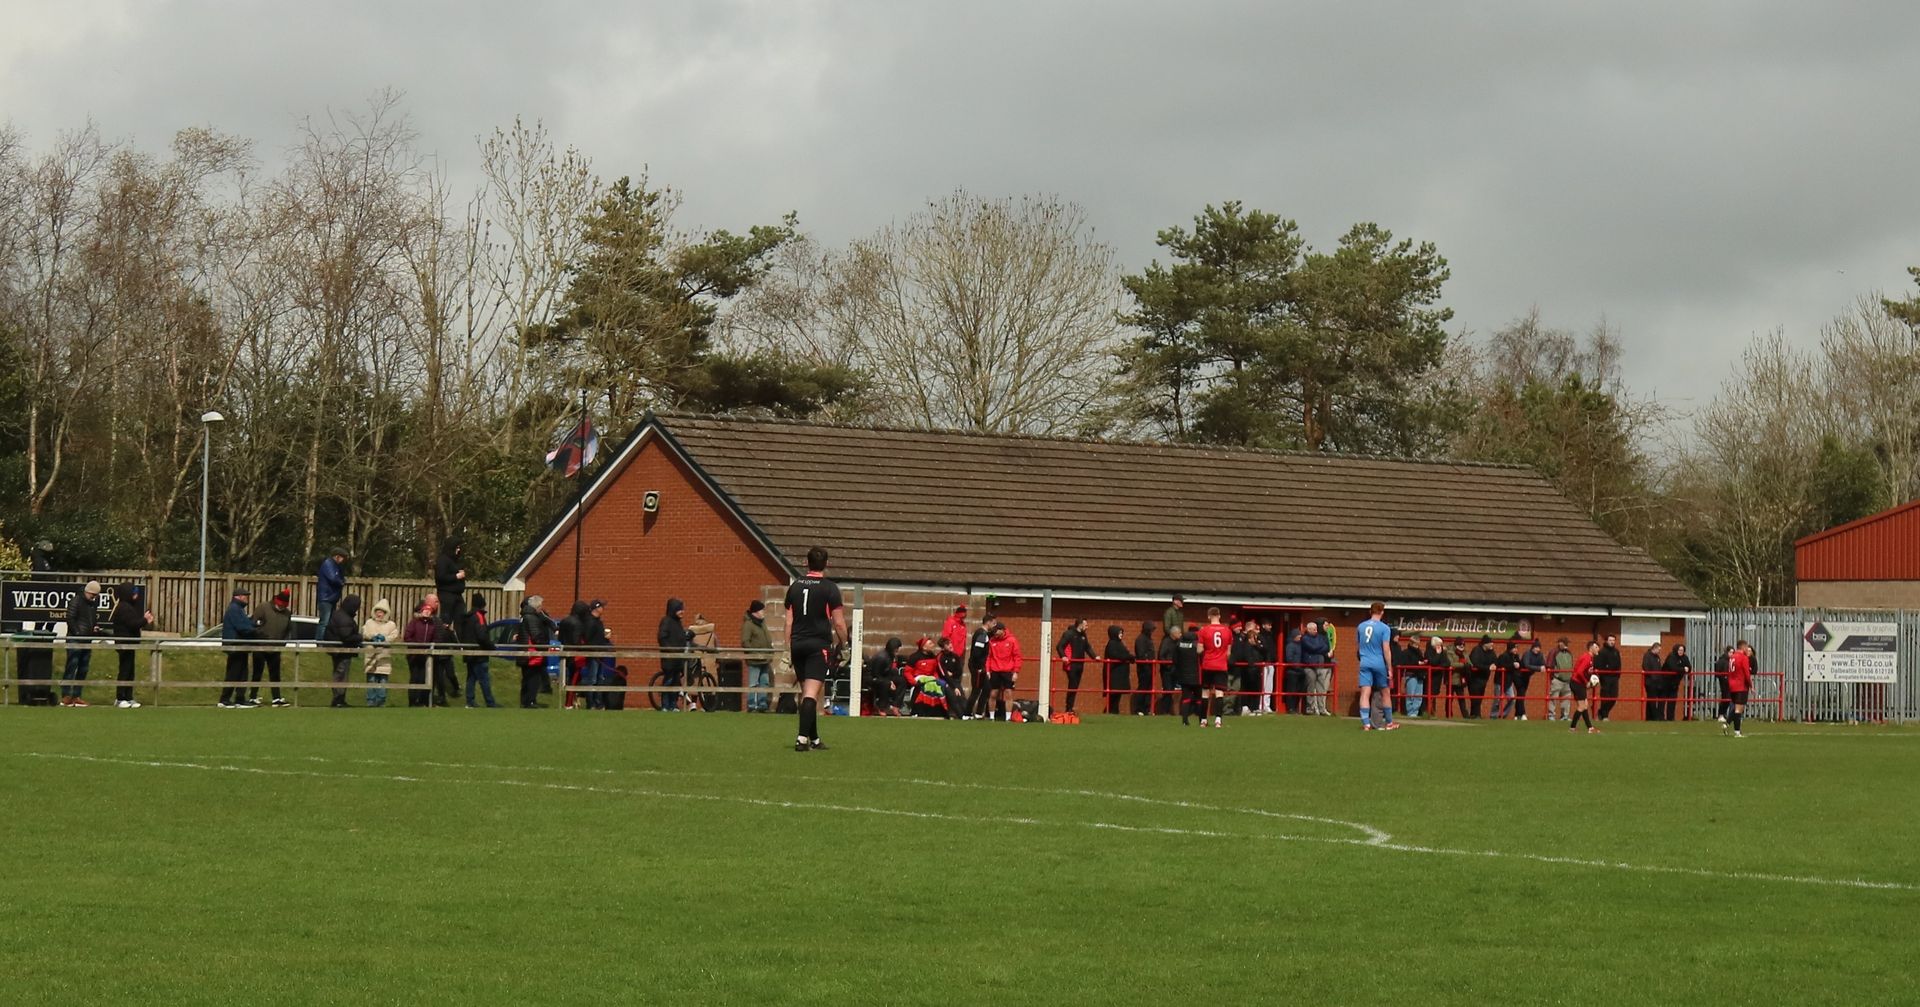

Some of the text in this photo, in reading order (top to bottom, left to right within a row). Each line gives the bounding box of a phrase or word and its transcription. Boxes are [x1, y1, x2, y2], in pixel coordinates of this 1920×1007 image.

[803, 589, 809, 615] 1
[1398, 616, 1441, 631] Lochar
[1442, 617, 1483, 633] Thistle
[1213, 631, 1222, 648] 6
[1365, 625, 1373, 643] 9
[1831, 659, 1893, 667] www.E-TEQ.co.uk
